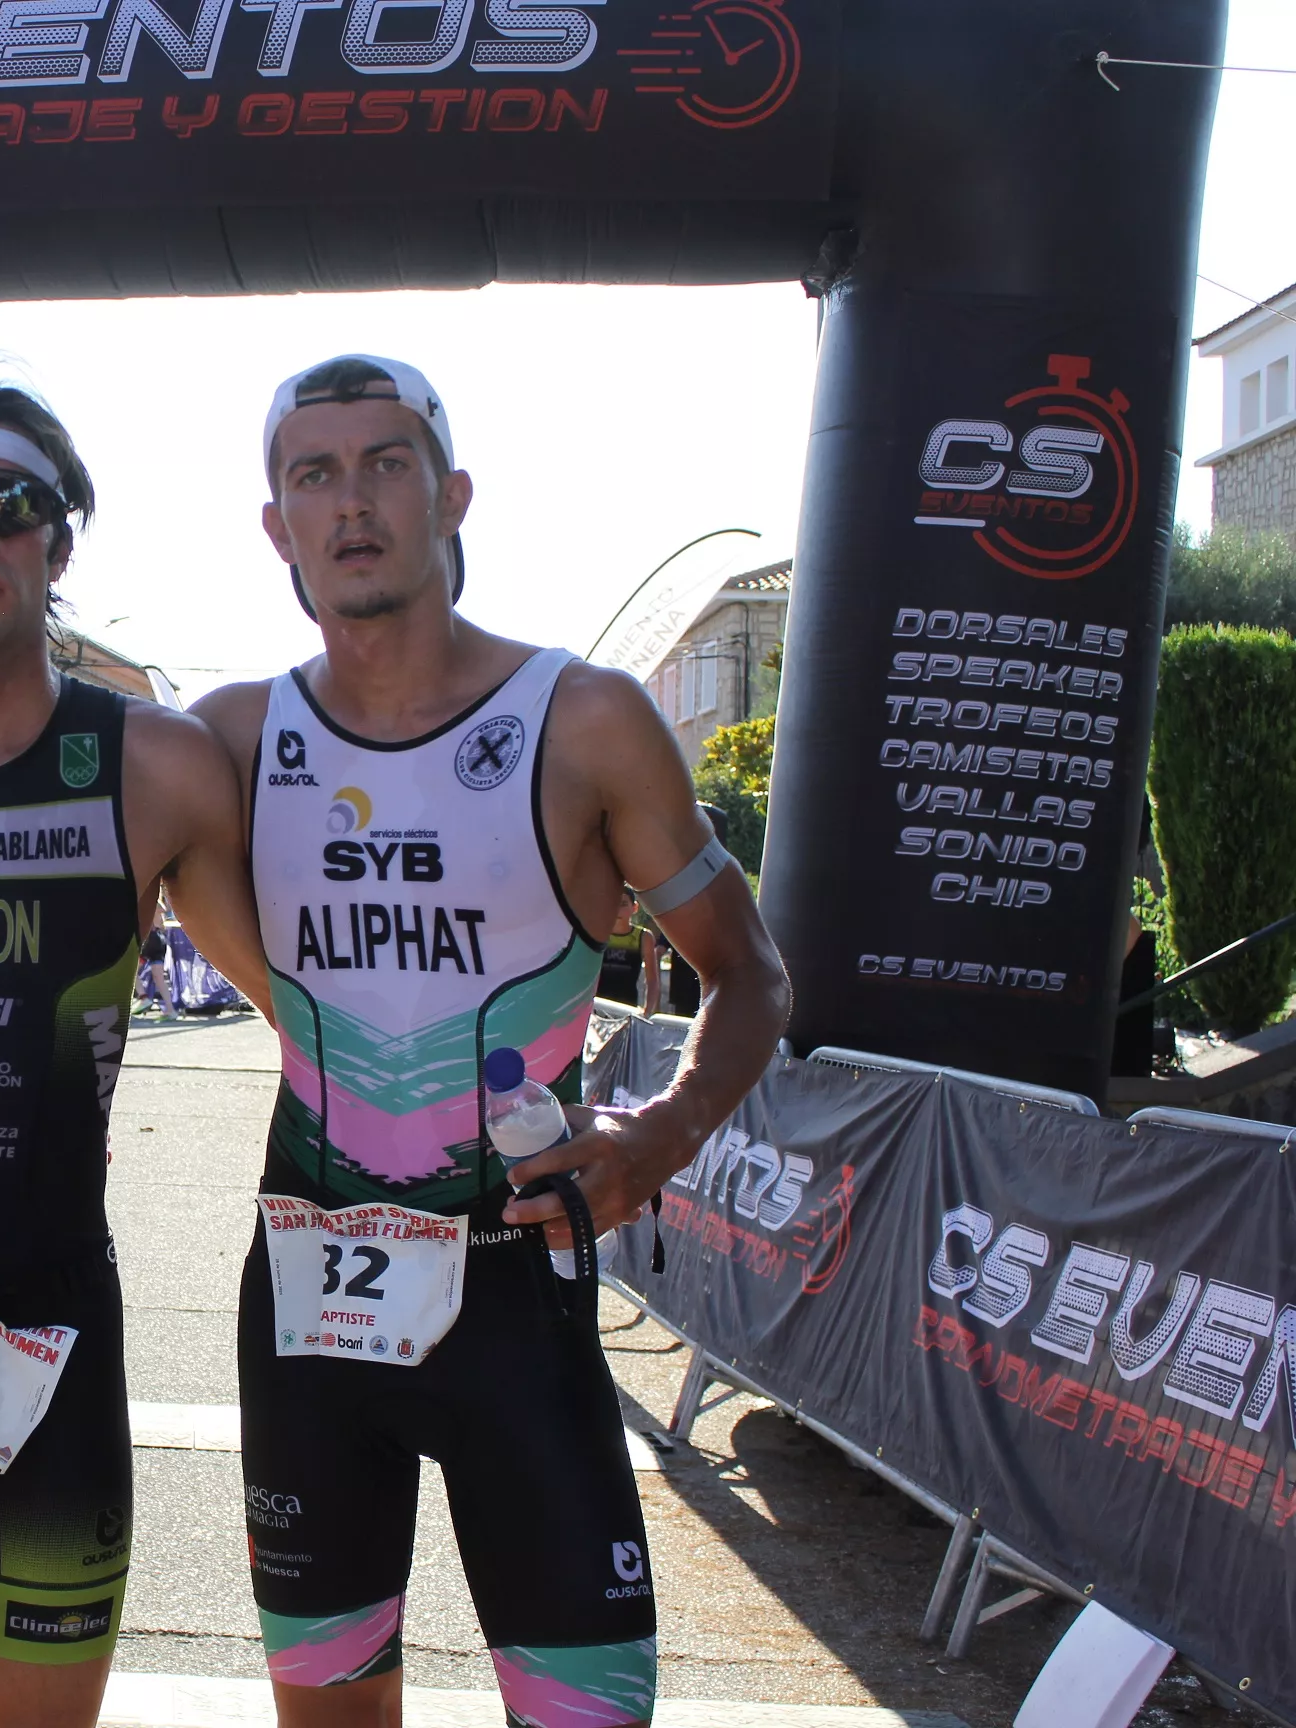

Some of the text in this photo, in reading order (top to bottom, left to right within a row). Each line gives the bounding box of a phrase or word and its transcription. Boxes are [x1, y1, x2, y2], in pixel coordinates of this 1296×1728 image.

[161, 95, 218, 138] Y
[237, 88, 608, 136] GESTION
[918, 417, 1104, 498] CS
[917, 491, 1094, 525] EVENTOS
[892, 607, 1128, 657] DORSALES
[887, 652, 1123, 700] SPEAKER
[885, 695, 1119, 744] TROFEOS
[879, 739, 1114, 788] CAMISETAS
[896, 782, 1096, 828] VALLAS
[323, 840, 444, 882] SYB
[894, 826, 1087, 871] SONIDO
[930, 872, 1052, 908] CHIP
[297, 903, 486, 975] ALIPHAT
[857, 954, 1067, 992] CS EVENTOS
[269, 1213, 307, 1231] SAN
[928, 1201, 1050, 1329] CS
[320, 1310, 376, 1326] APTISTE
[337, 1334, 364, 1351] barri
[262, 1562, 300, 1577] Huesca
